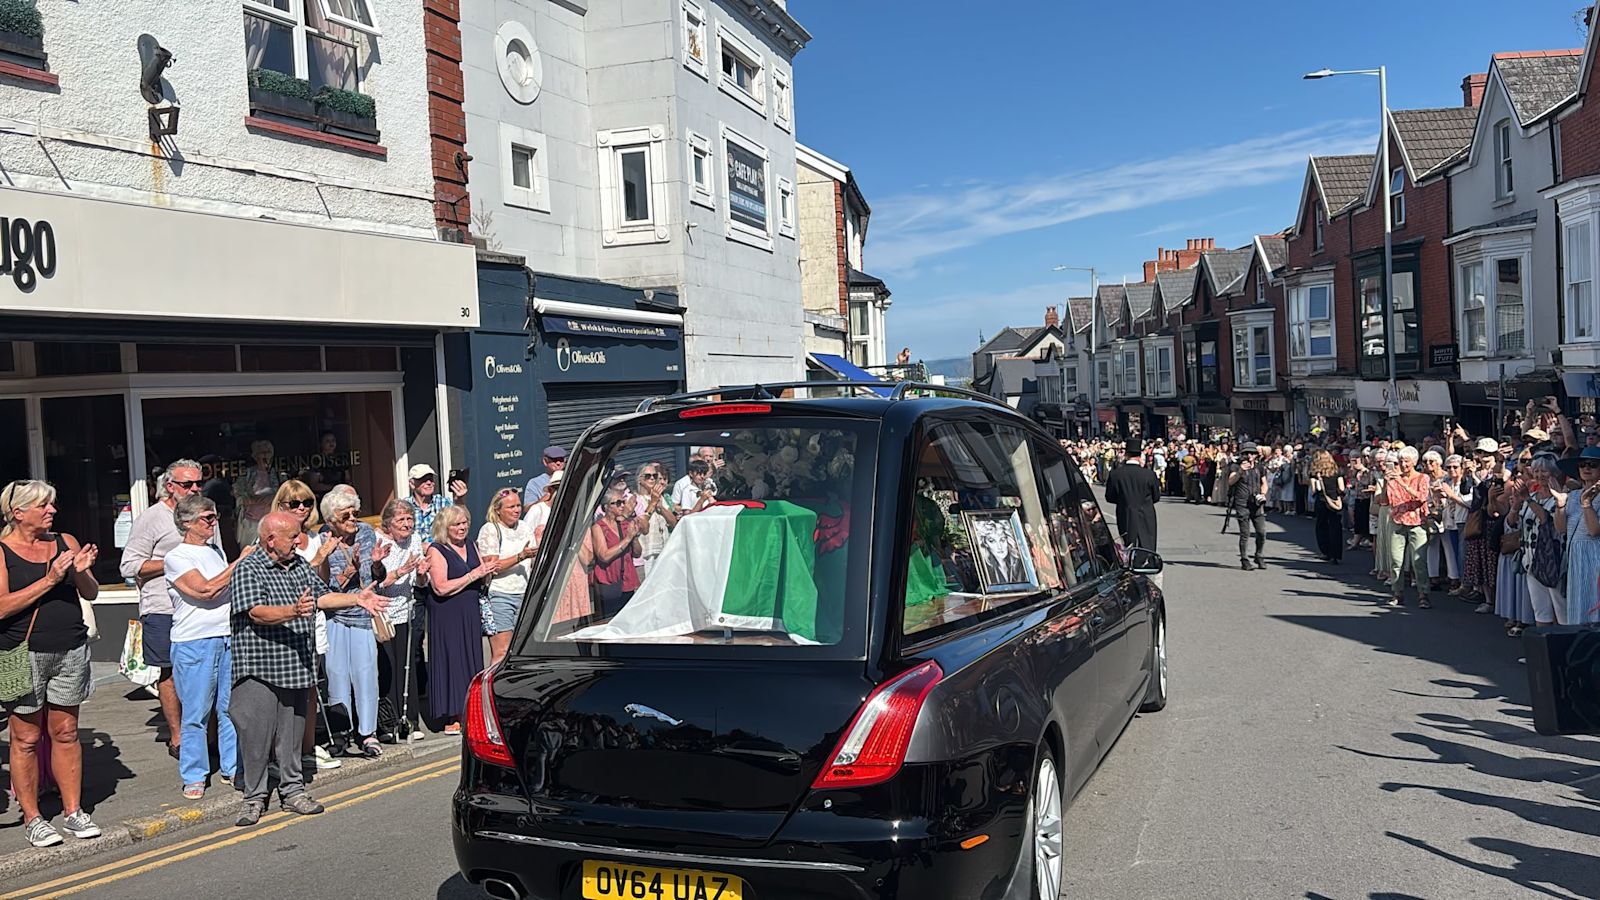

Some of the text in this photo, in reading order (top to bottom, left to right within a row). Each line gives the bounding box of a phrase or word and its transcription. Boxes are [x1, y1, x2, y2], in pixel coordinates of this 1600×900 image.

[461, 307, 470, 318] 30
[1329, 397, 1354, 411] HOUSE
[202, 459, 247, 481] OFFEE
[597, 867, 729, 900] OV64 UAZ
